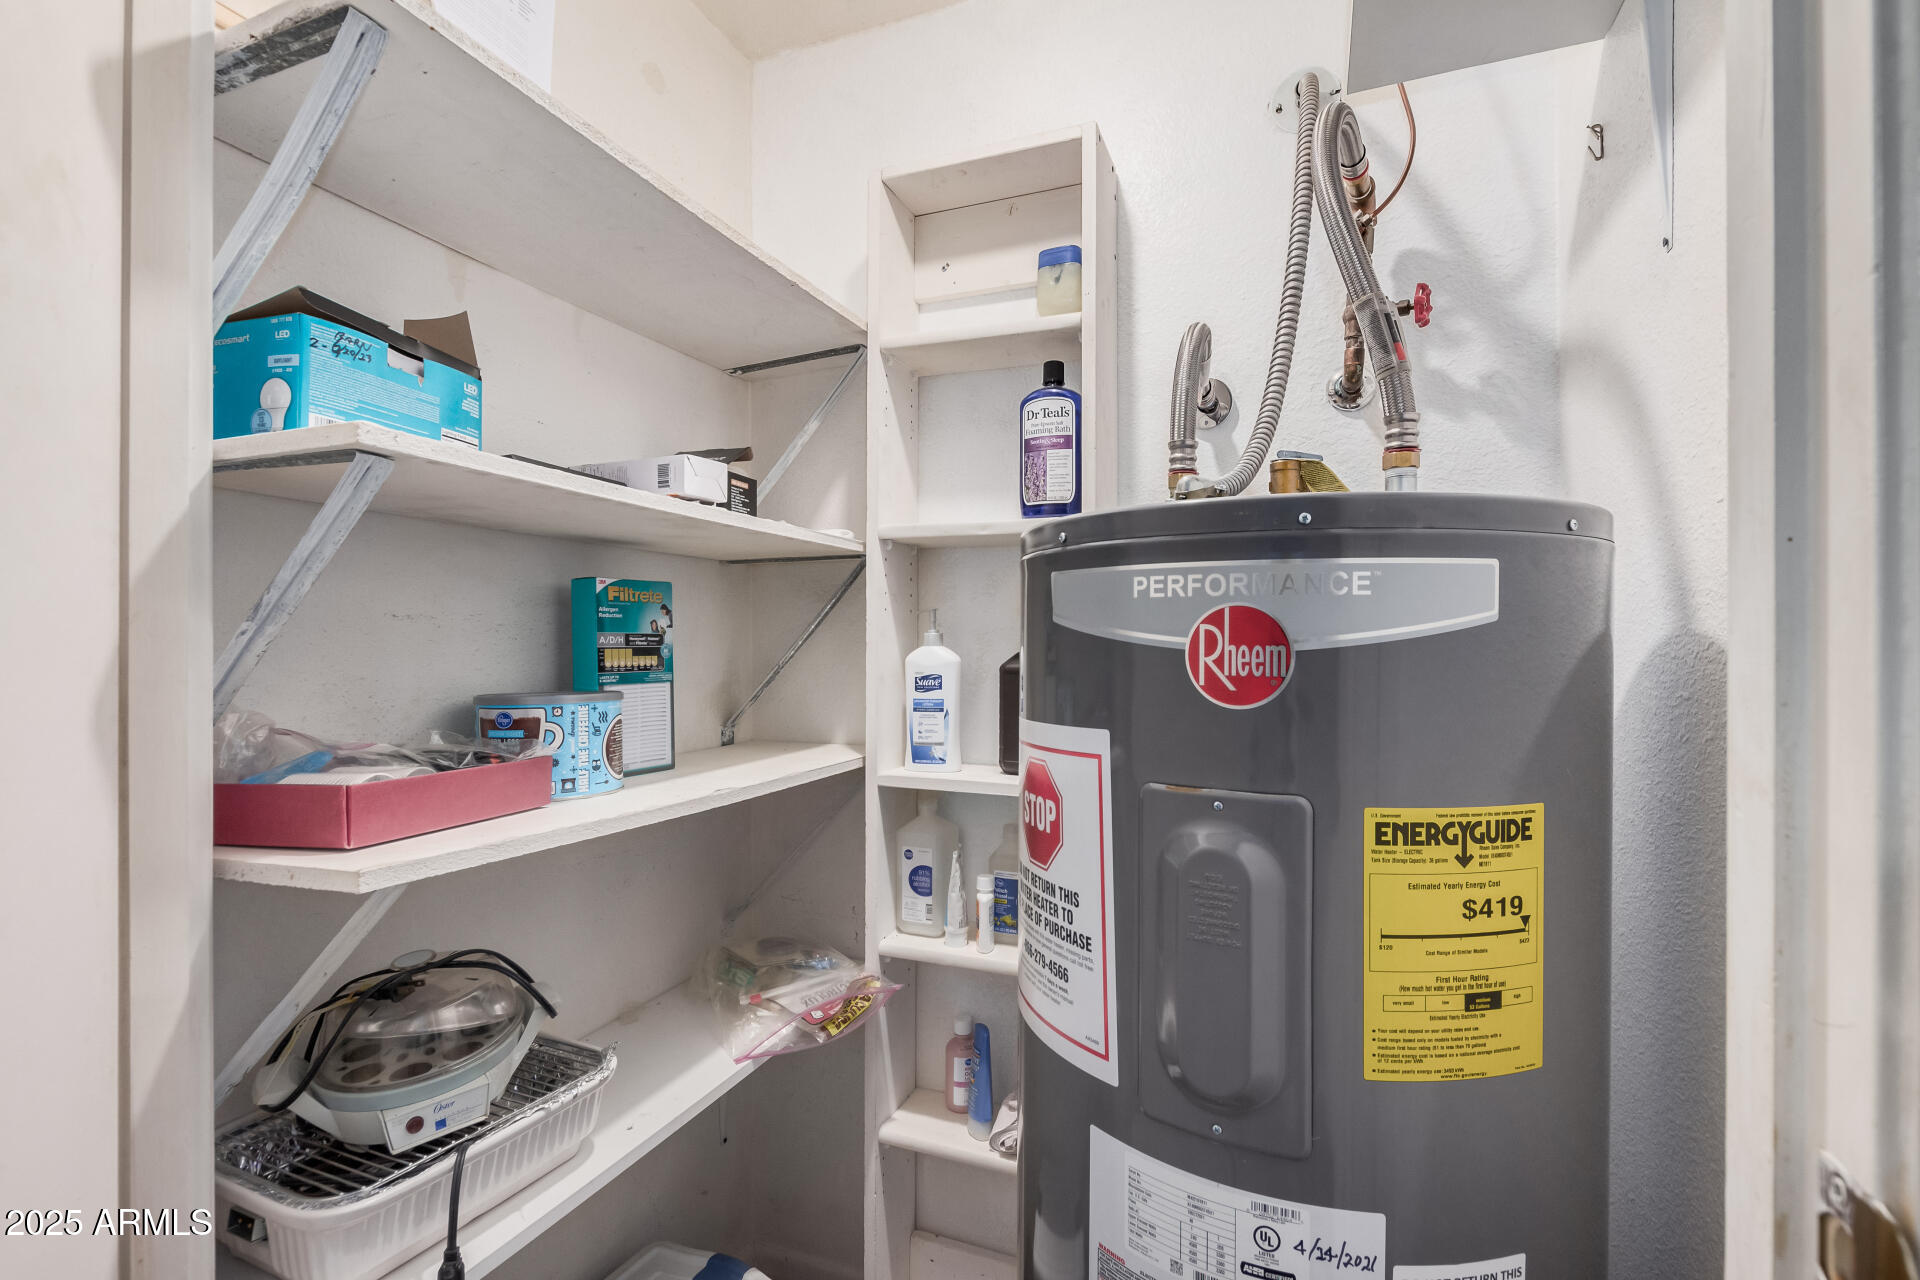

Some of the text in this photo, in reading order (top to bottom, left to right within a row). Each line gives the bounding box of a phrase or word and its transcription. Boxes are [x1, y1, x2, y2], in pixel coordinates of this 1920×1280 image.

[274, 330, 290, 338] LED
[464, 382, 478, 396] LED
[1027, 406, 1070, 421] Dr Teal's
[1026, 428, 1053, 436] Foaming
[1133, 571, 1372, 598] PERFORMANCE
[608, 586, 663, 604] Filtrete
[600, 636, 624, 644] A/D/H
[1199, 606, 1287, 692] Rheem
[916, 678, 941, 686] Suave
[1024, 790, 1056, 834] STOP
[1375, 816, 1532, 847] ENERGYGUIDE
[1031, 872, 1056, 899] RETURN
[1058, 886, 1079, 908] THIS
[1443, 882, 1463, 890] Yearly
[1465, 881, 1486, 890] Energy
[1033, 892, 1059, 919] HEATER
[1061, 906, 1073, 925] TO
[1462, 895, 1523, 922] $419
[1035, 910, 1042, 927] OF
[1045, 917, 1092, 953] PURCHASE
[1470, 974, 1489, 982] Rating
[434, 1100, 456, 1114] Oster
[1260, 1230, 1274, 1248] UL
[1099, 1241, 1126, 1266] WARNING
[1455, 1266, 1522, 1280] URN THIS
